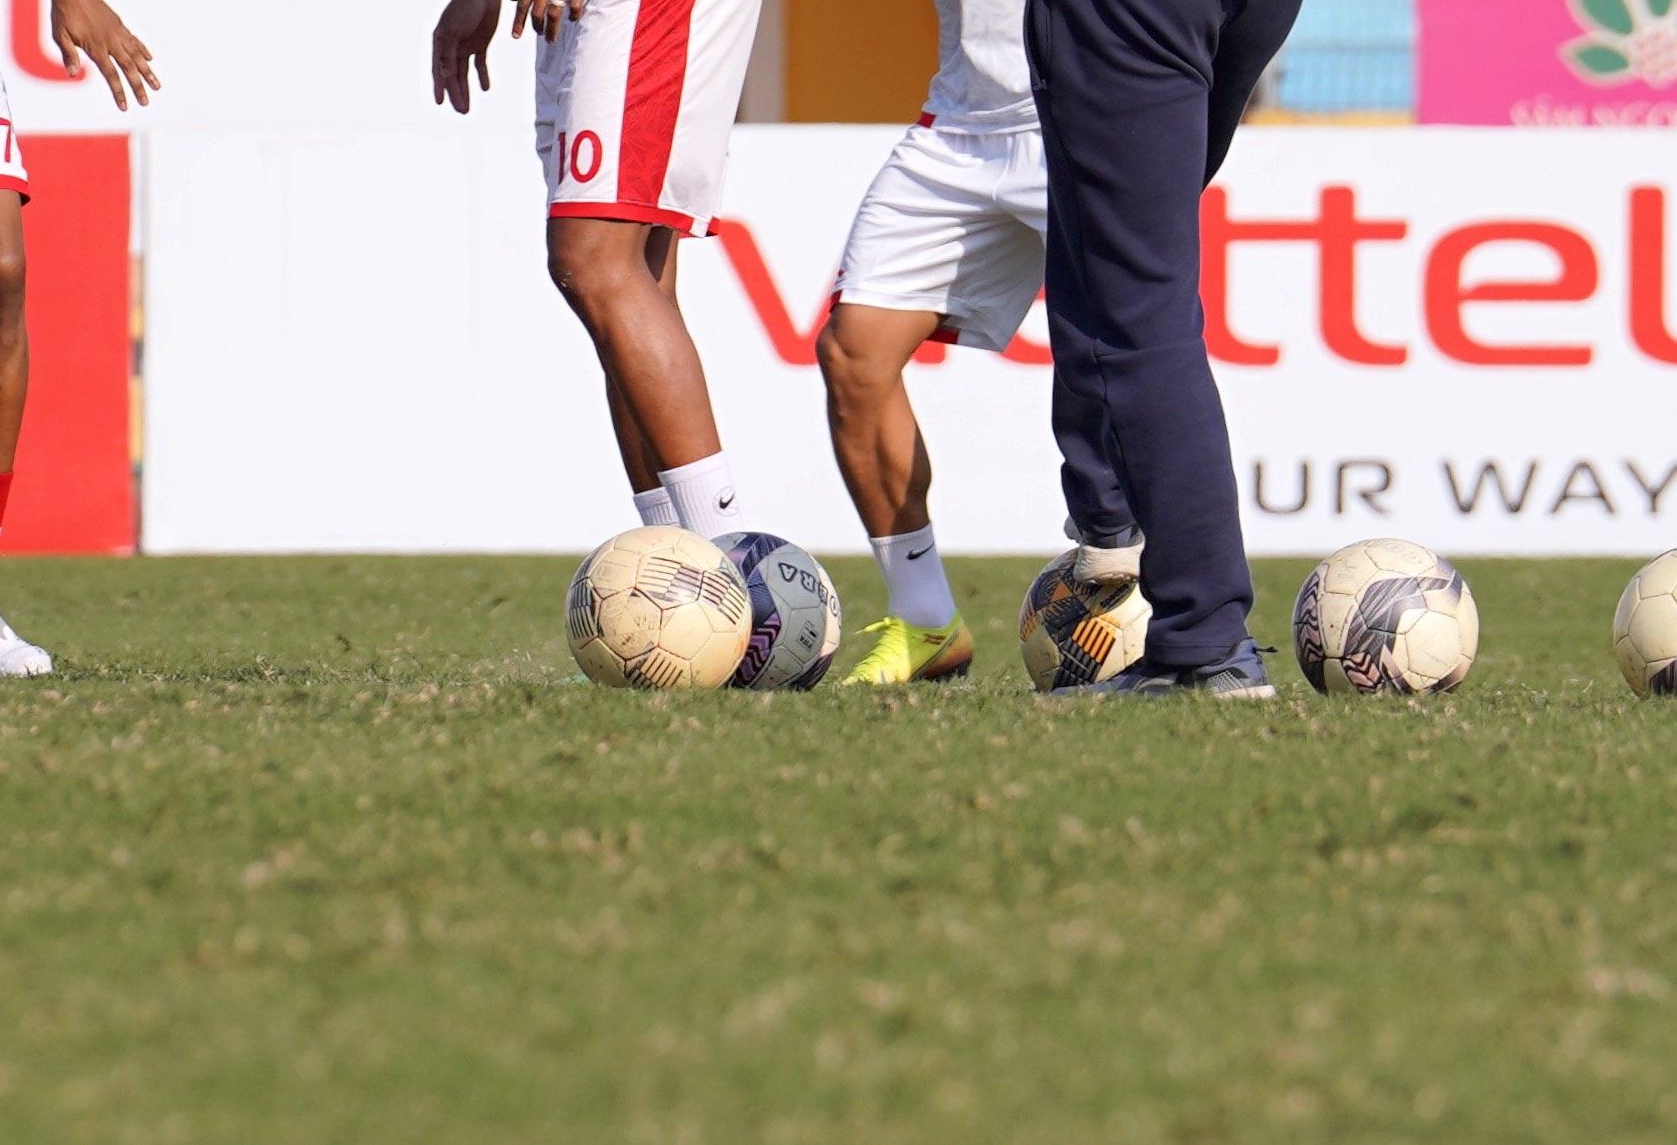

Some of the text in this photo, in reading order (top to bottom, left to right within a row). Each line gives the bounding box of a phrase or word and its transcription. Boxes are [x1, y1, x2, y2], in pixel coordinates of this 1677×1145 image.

[558, 129, 603, 184] 10
[720, 186, 1677, 366] vttel
[1254, 460, 1677, 515] UR WAY
